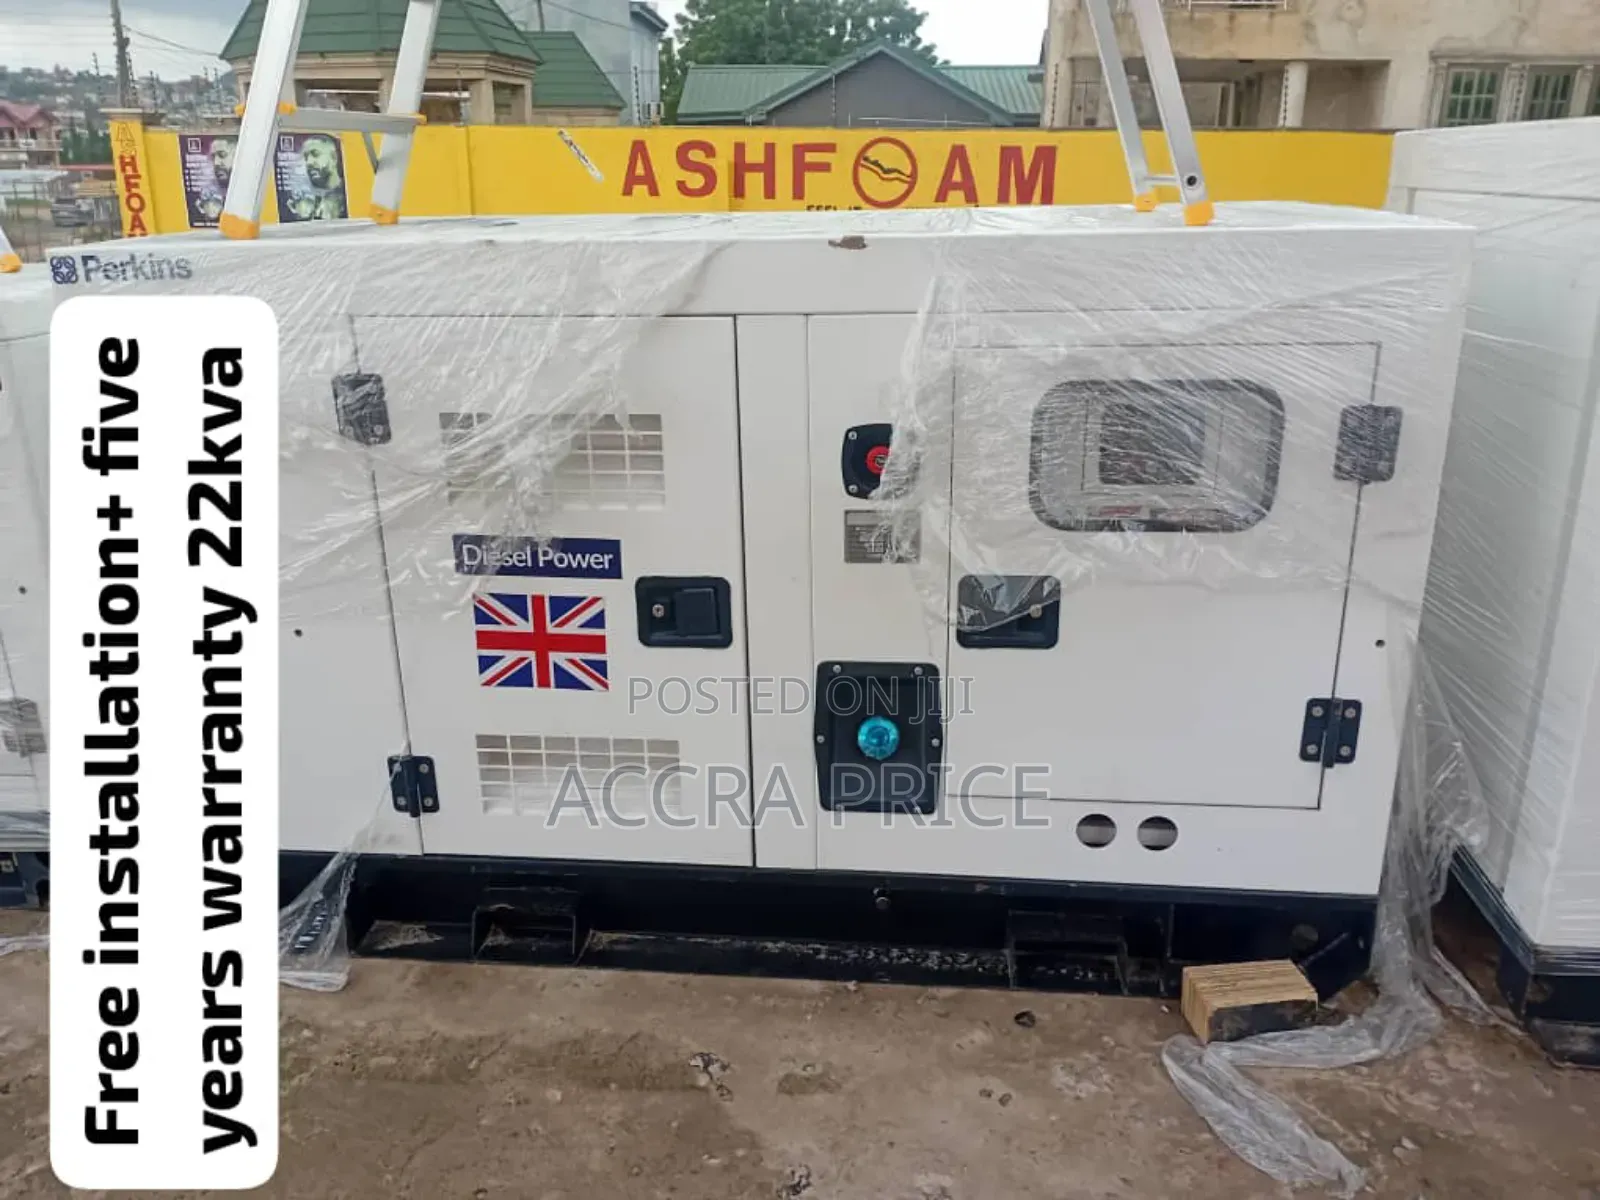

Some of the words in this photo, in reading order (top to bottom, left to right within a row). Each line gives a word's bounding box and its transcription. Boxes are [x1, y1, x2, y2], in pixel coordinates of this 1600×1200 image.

[623, 136, 1058, 208] ASHFOAM
[81, 252, 193, 283] Perkins
[462, 544, 531, 568] Diesel
[538, 547, 614, 570] Power
